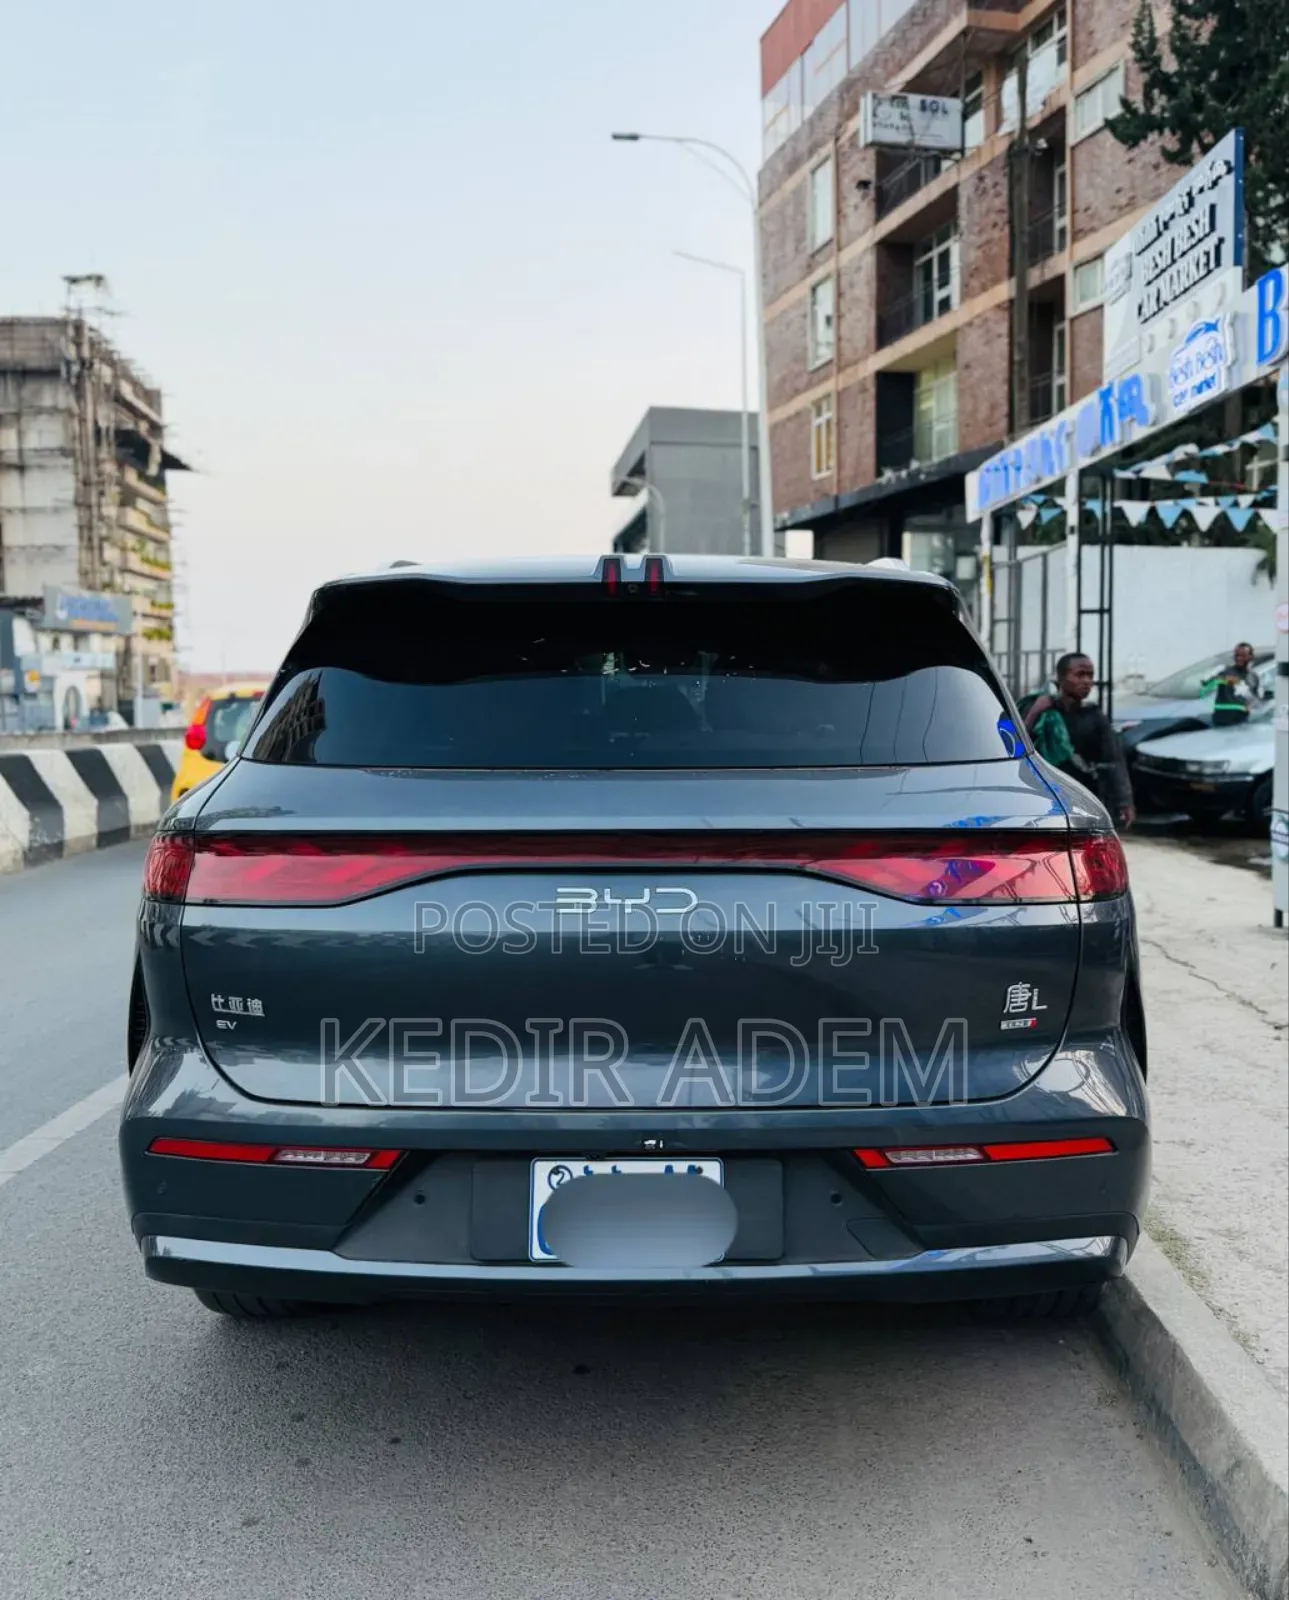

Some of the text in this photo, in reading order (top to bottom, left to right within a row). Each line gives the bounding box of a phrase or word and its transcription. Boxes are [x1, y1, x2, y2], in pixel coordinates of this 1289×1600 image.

[556, 887, 699, 915] BYD
[210, 993, 265, 1017] 比亚迪
[215, 1019, 237, 1030] EV
